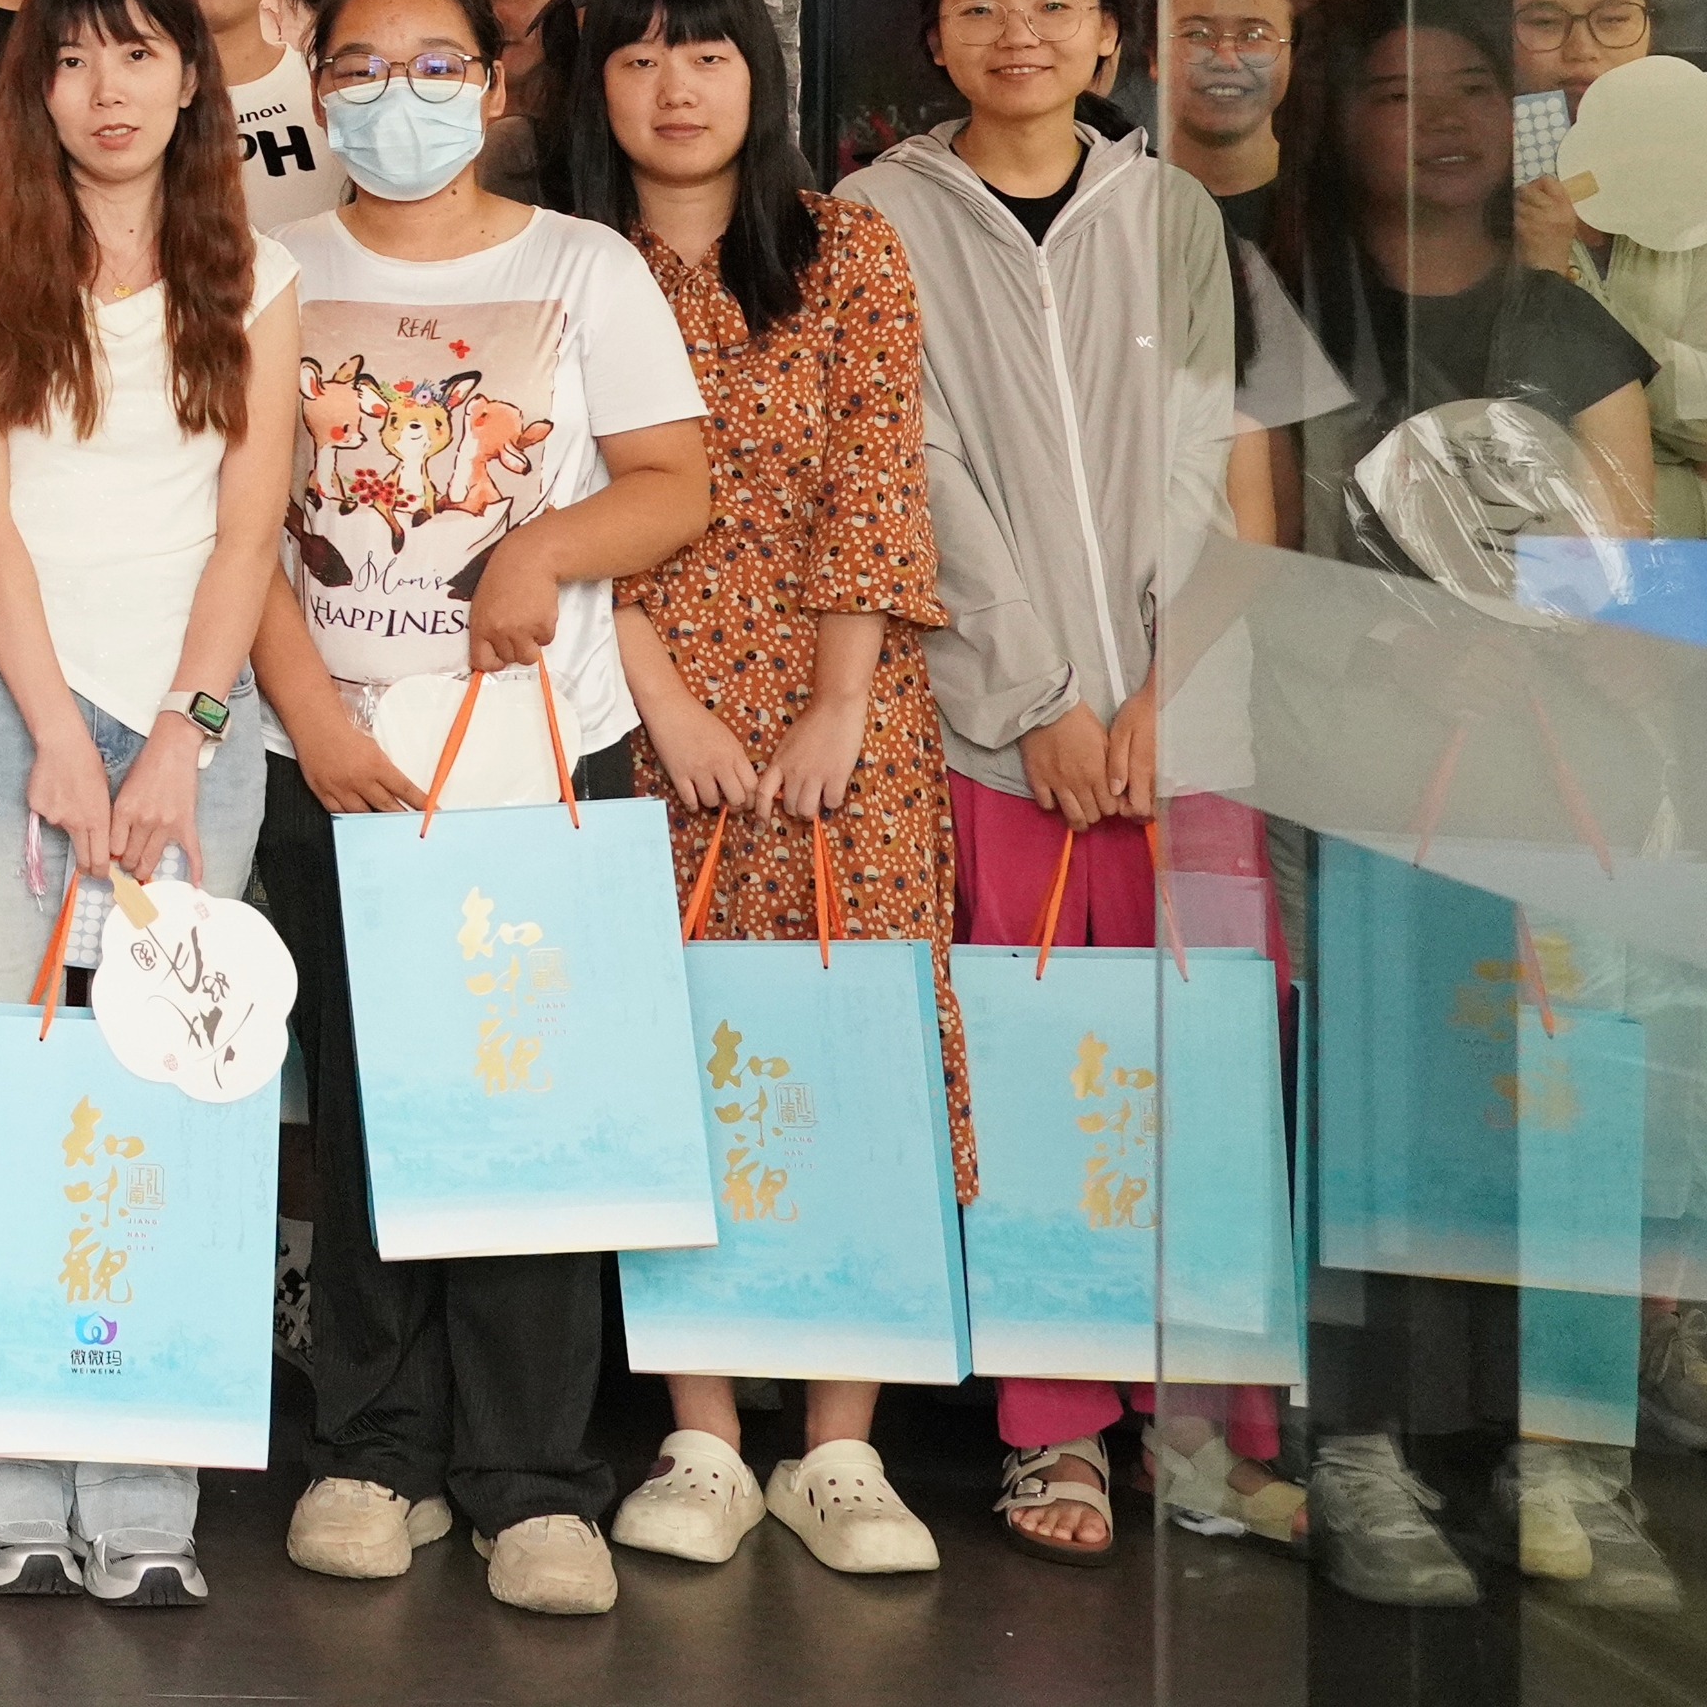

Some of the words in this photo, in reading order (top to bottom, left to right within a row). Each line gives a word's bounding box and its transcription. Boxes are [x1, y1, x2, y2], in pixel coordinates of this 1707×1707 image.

[397, 317, 442, 341] REAL
[310, 595, 470, 638] HAPPINES
[70, 1349, 122, 1367] 微微玛
[71, 1367, 122, 1375] WEIWEIMA
